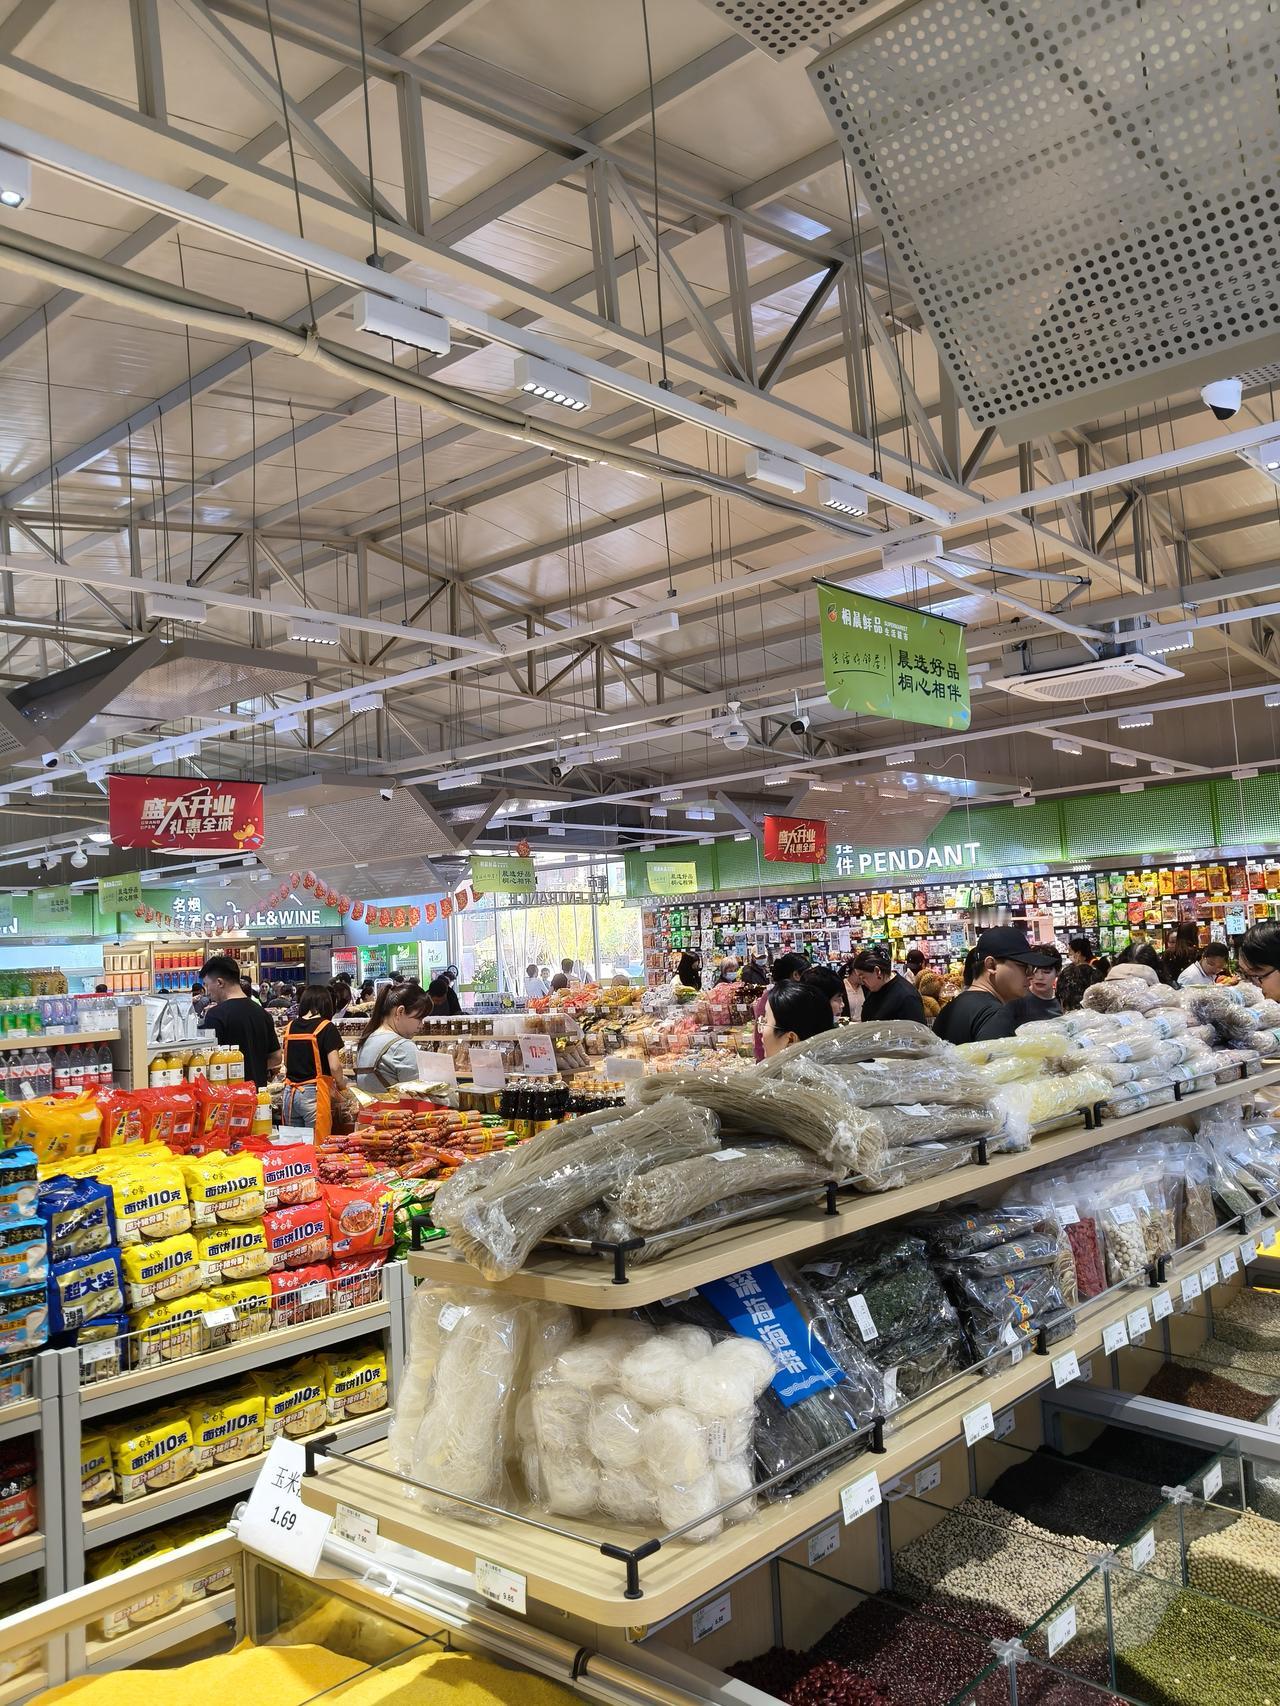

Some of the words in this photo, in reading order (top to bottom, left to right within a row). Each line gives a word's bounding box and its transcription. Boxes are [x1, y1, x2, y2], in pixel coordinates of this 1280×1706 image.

[898, 650, 960, 680] 晨选好品
[898, 673, 962, 702] 桐心相伴
[141, 795, 235, 833] 盛大开业
[170, 817, 233, 834] 礼惠全城
[778, 829, 816, 852] 盛大开业
[860, 842, 980, 874] PENDANT
[173, 897, 201, 912] 名烟
[266, 1163, 312, 1182] 面饼110克
[205, 1177, 258, 1197] 面饼110克
[124, 1190, 182, 1214] 面饼110克
[208, 1233, 263, 1256] 面饼110克
[273, 1222, 324, 1248] 面饼110克
[141, 1250, 193, 1279] 面饼110克
[64, 1270, 114, 1302] 超大袋
[335, 1367, 381, 1393] 面饼110克
[274, 1386, 320, 1415] 面饼110克
[203, 1413, 258, 1442] 面饼110克
[132, 1431, 188, 1470] 面饼110克
[271, 1466, 301, 1497] 玉米
[270, 1505, 297, 1531] 1.69
